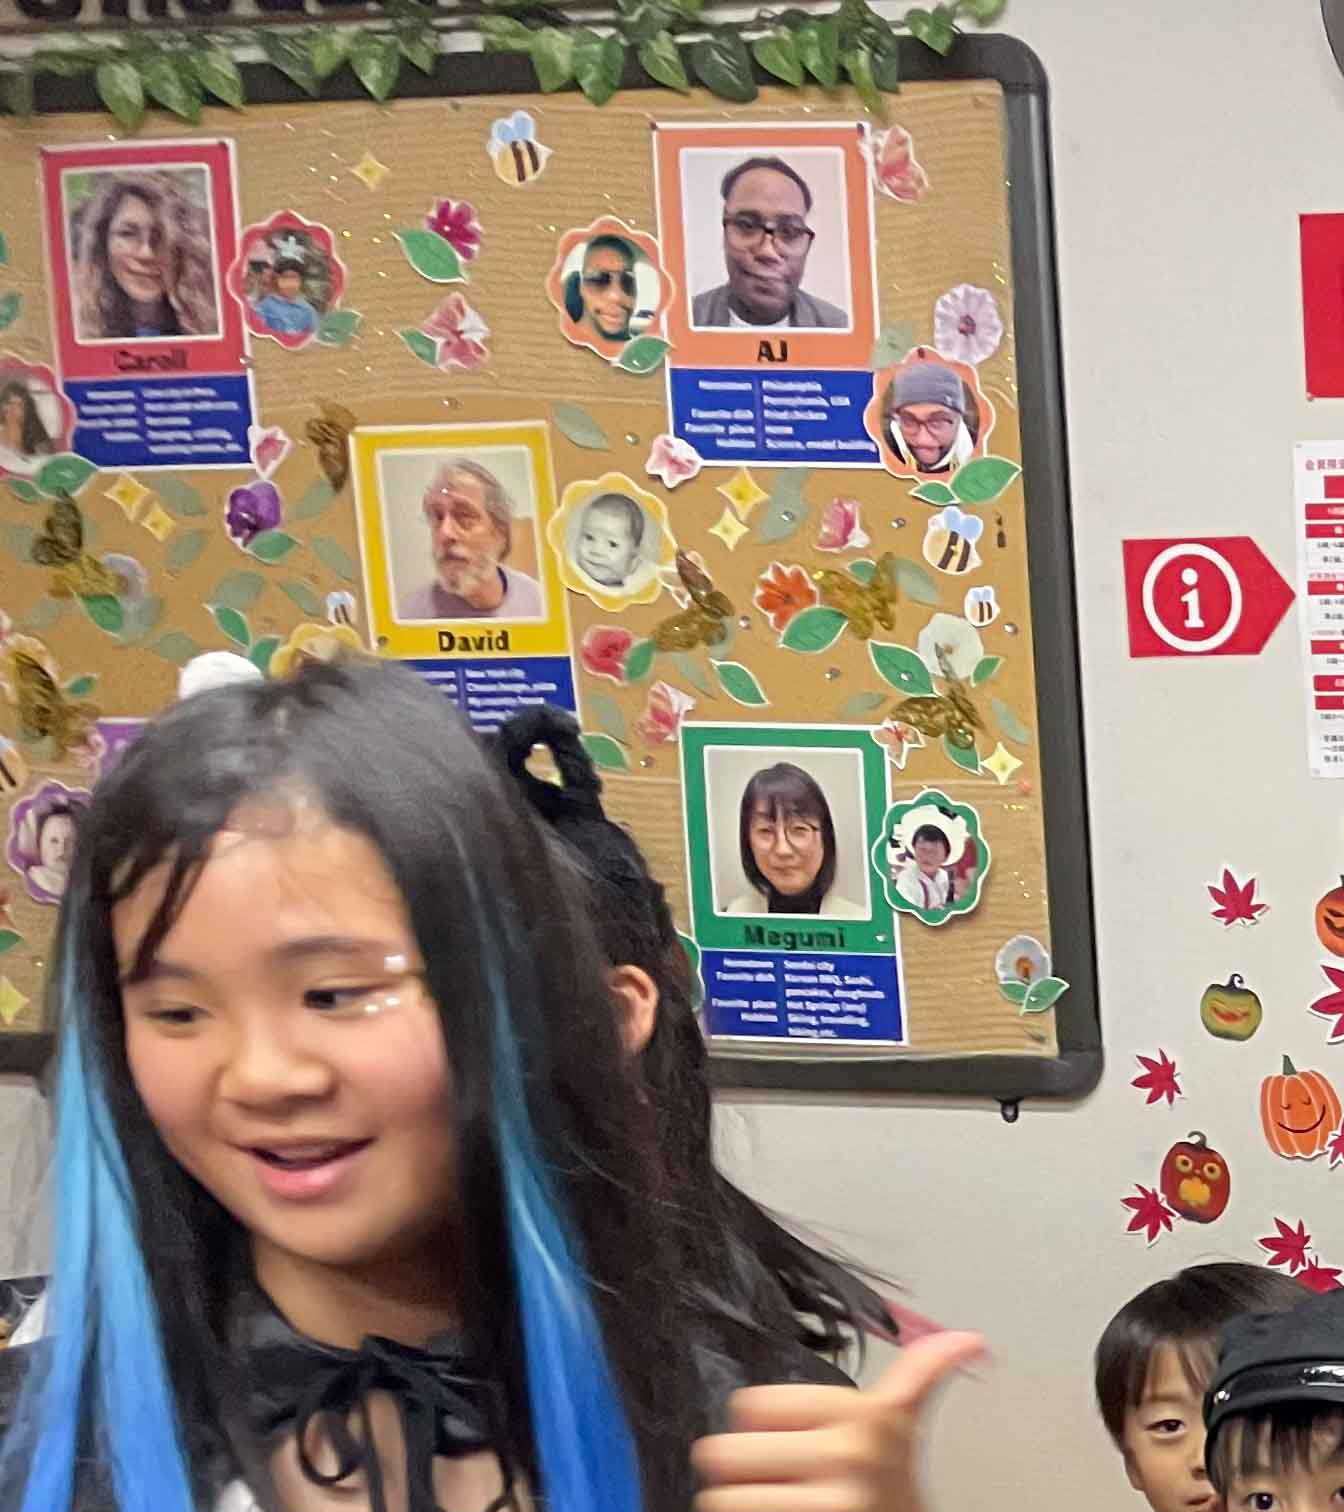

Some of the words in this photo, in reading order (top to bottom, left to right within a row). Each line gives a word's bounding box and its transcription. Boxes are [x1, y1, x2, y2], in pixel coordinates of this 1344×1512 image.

[757, 340, 789, 362] AJ
[438, 630, 510, 652] David
[744, 925, 845, 950] Megumi
